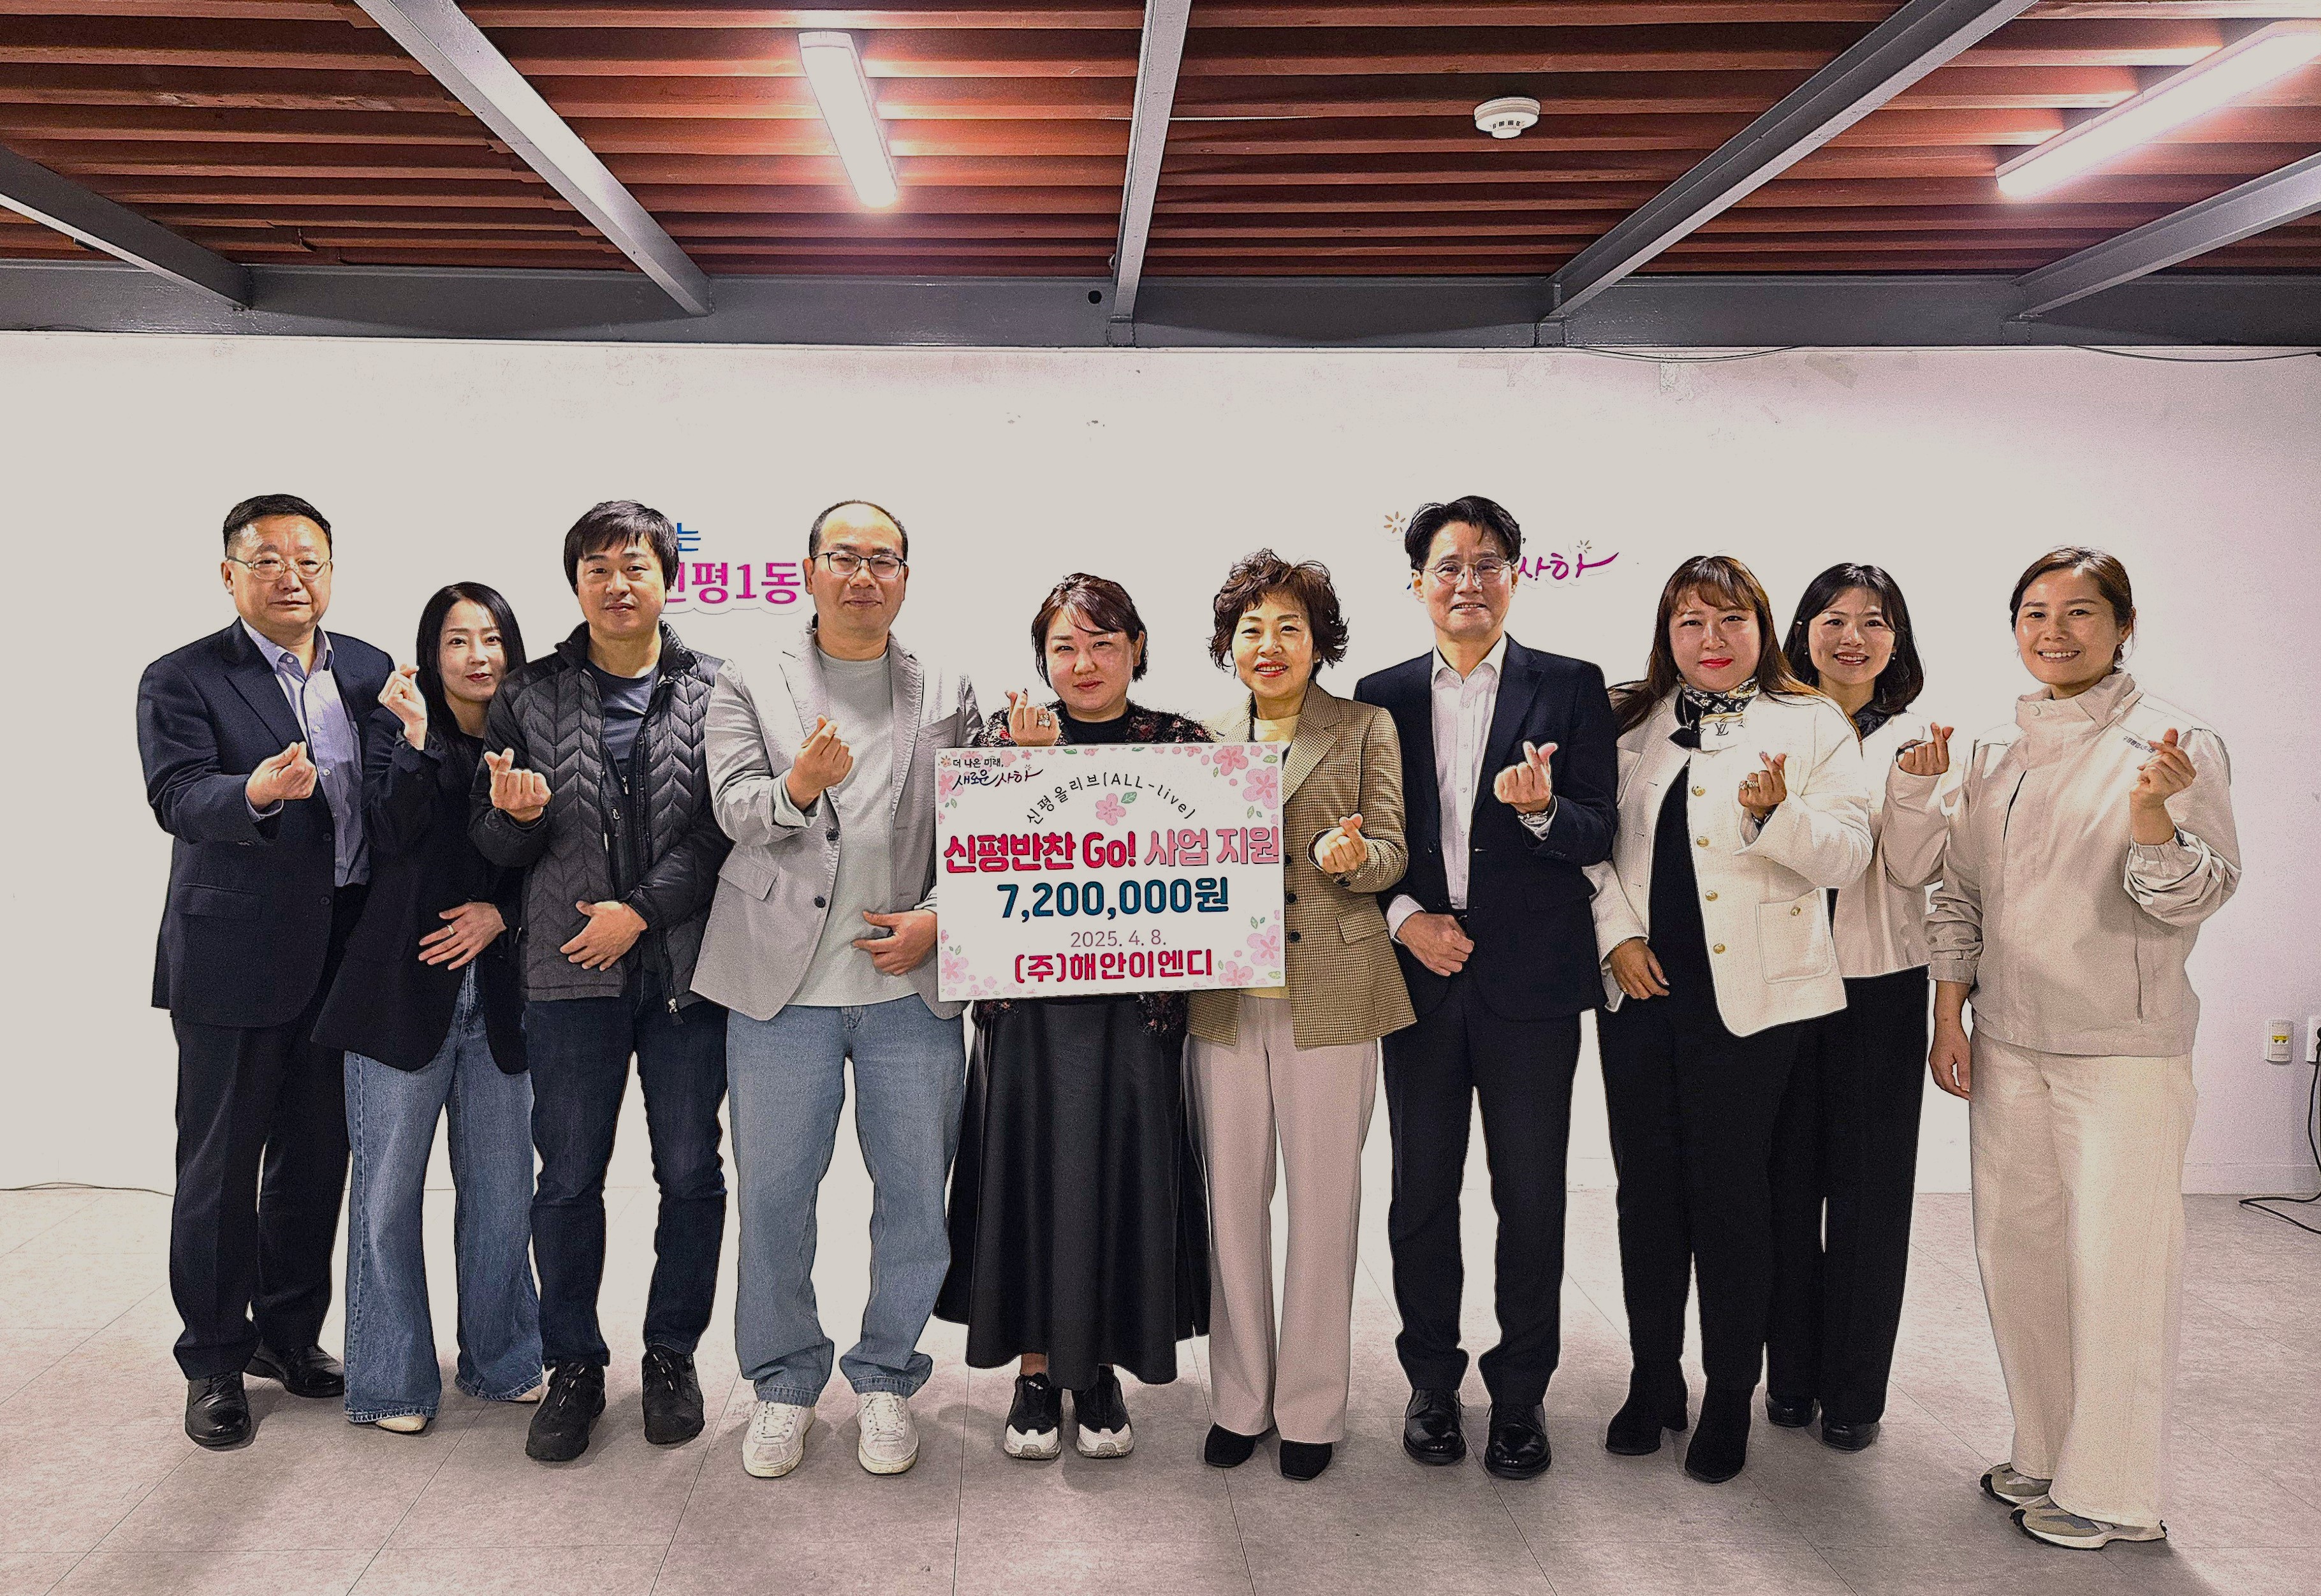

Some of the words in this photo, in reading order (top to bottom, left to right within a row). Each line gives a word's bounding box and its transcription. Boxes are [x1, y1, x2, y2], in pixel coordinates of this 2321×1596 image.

[953, 758, 962, 768] 더
[964, 758, 981, 768] 나은
[983, 757, 1004, 768] 미래,
[952, 769, 999, 791] 새로운
[994, 768, 1044, 787] 사하
[943, 831, 1076, 874] 신평반찬
[1082, 831, 1136, 869] Go!
[1143, 828, 1209, 867] 사업
[1215, 824, 1280, 865] 지원
[997, 876, 1229, 923] 7,200,000원
[1071, 930, 1123, 948] 2025.
[1128, 930, 1145, 946] 4.
[1151, 929, 1167, 946] 8.
[1014, 949, 1213, 983] (주)해안이엔디
